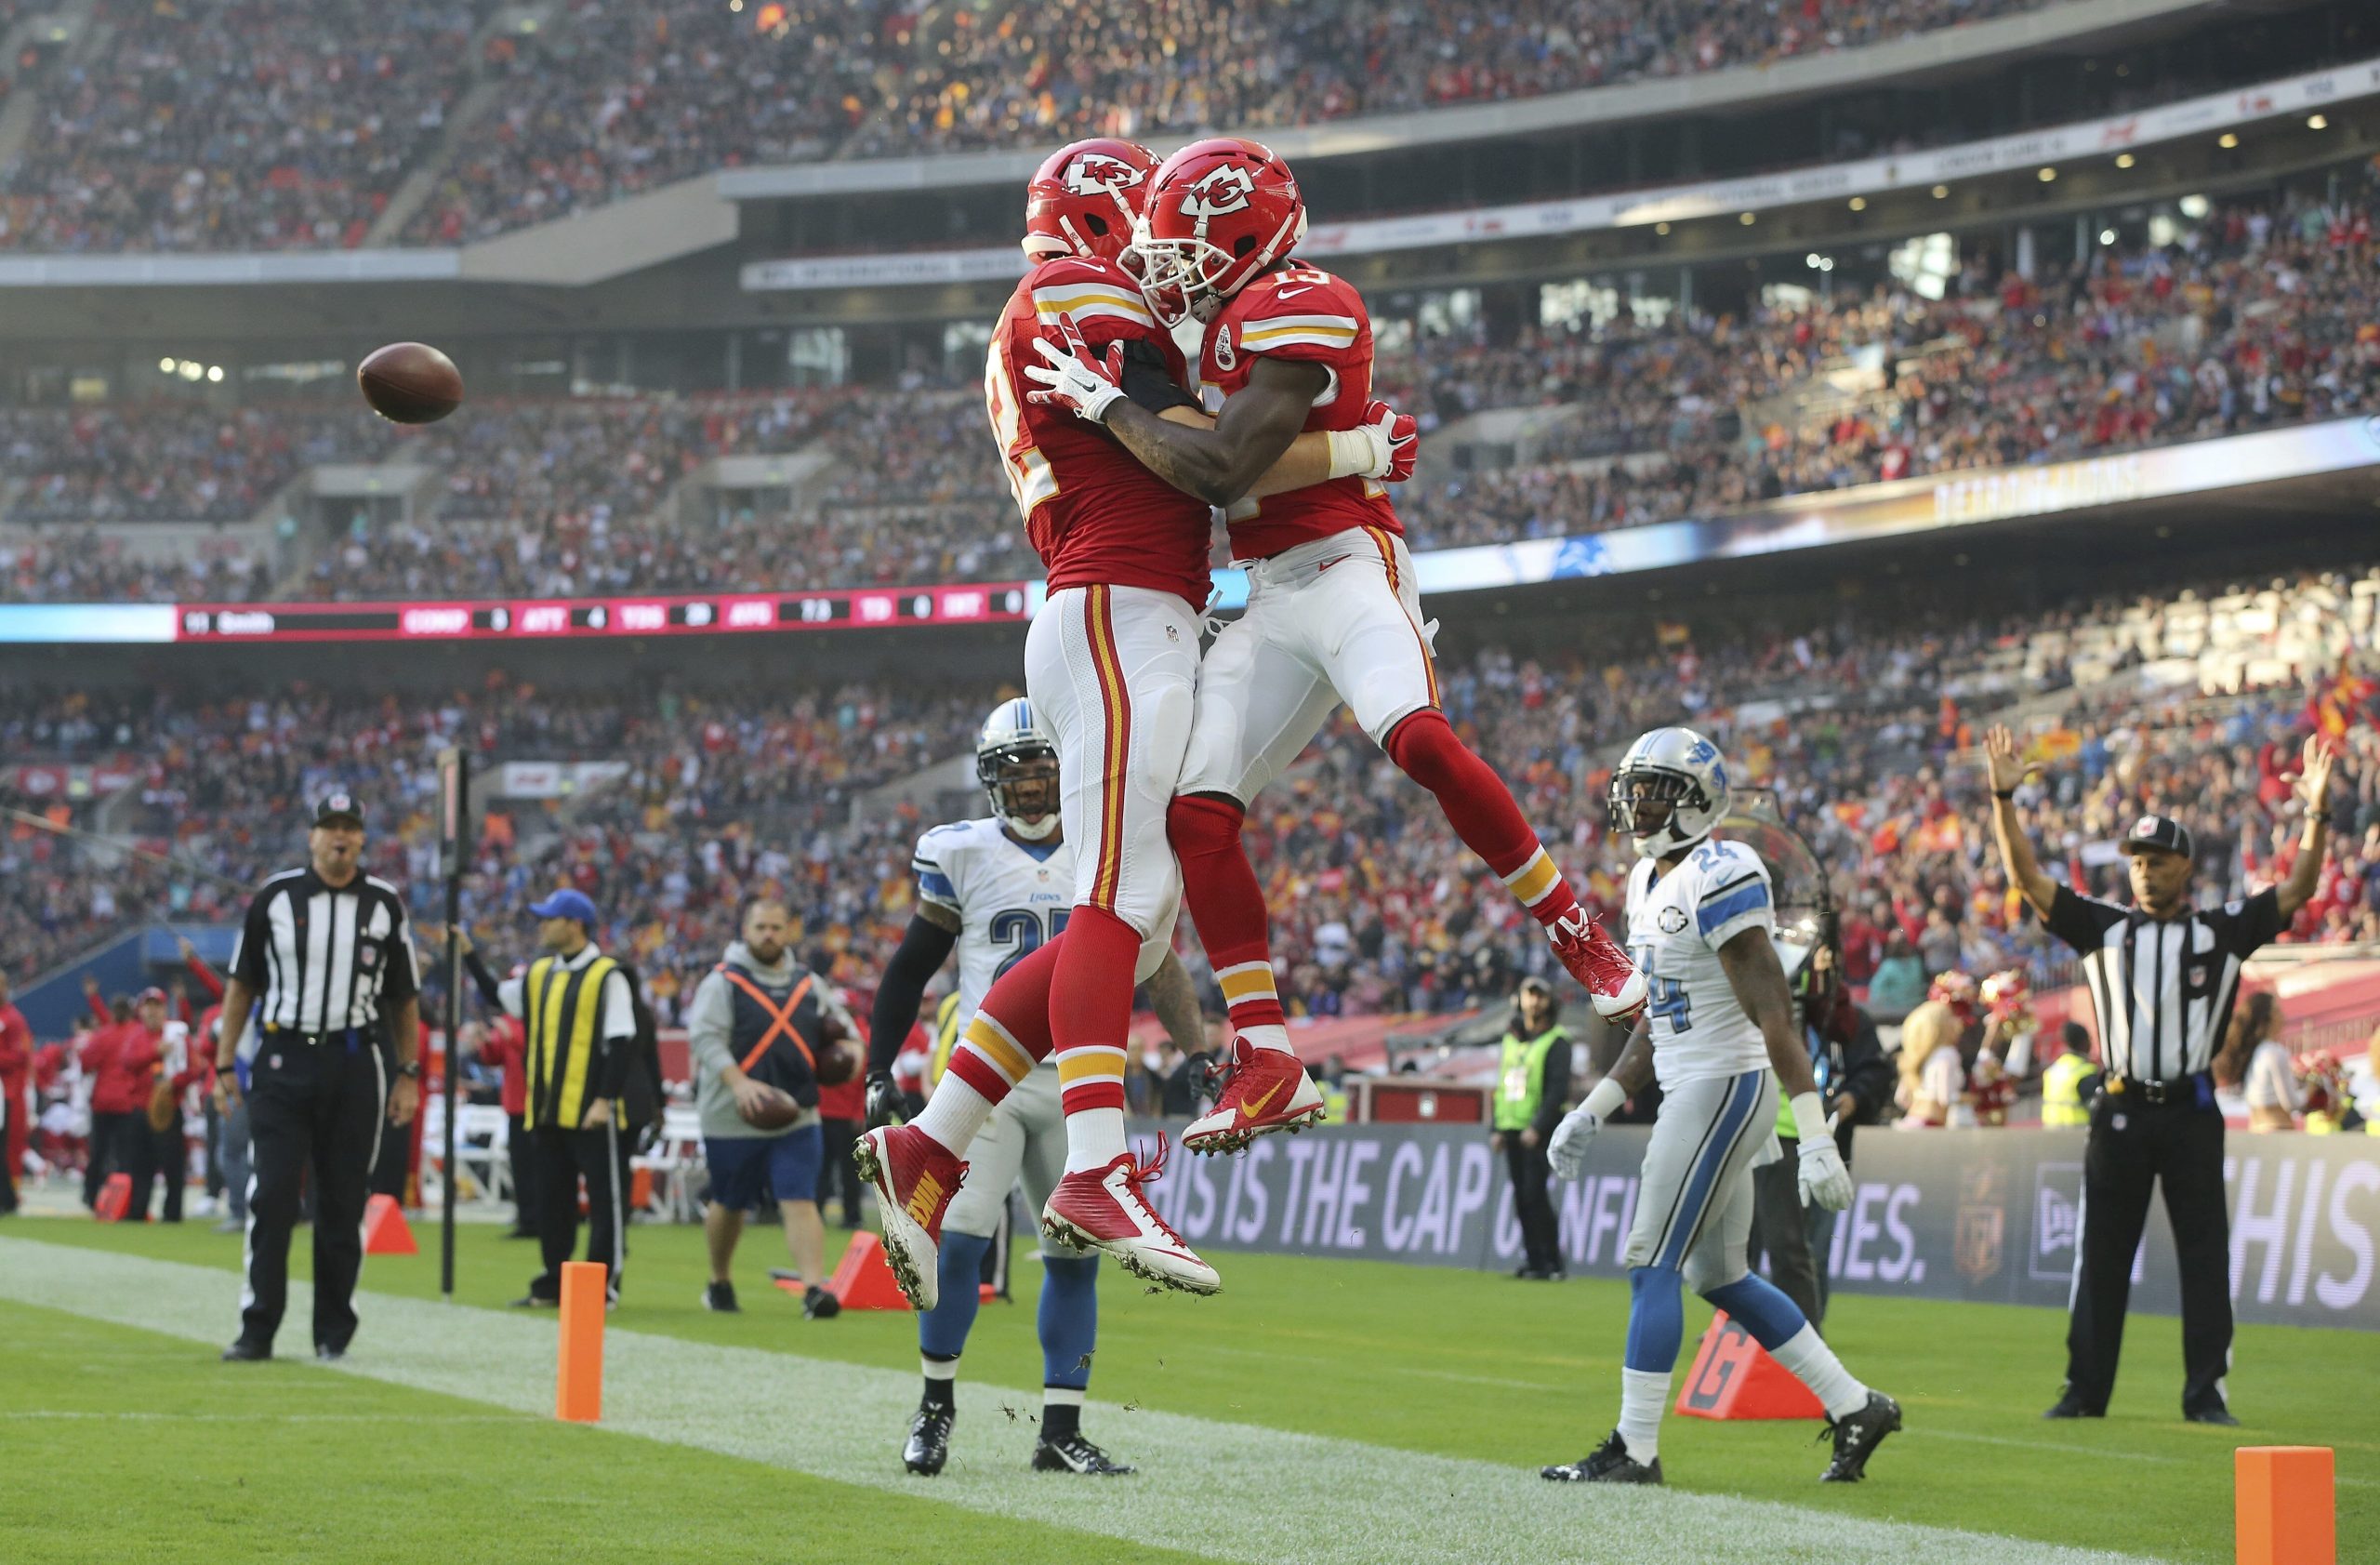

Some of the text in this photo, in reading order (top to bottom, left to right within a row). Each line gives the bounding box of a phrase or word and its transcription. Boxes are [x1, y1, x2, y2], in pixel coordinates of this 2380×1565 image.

[1082, 160, 1132, 186] KC
[1192, 176, 1245, 208] KC
[1691, 840, 1739, 873] 24
[989, 907, 1073, 988] 2
[906, 1169, 944, 1229] NIKE
[1221, 1140, 1276, 1245] IS
[1279, 1140, 1384, 1249] THE
[1382, 1141, 1491, 1256] CAP
[1828, 1184, 1926, 1282] IES.
[2224, 1156, 2380, 1310] HIS
[1687, 1320, 1750, 1411] G
